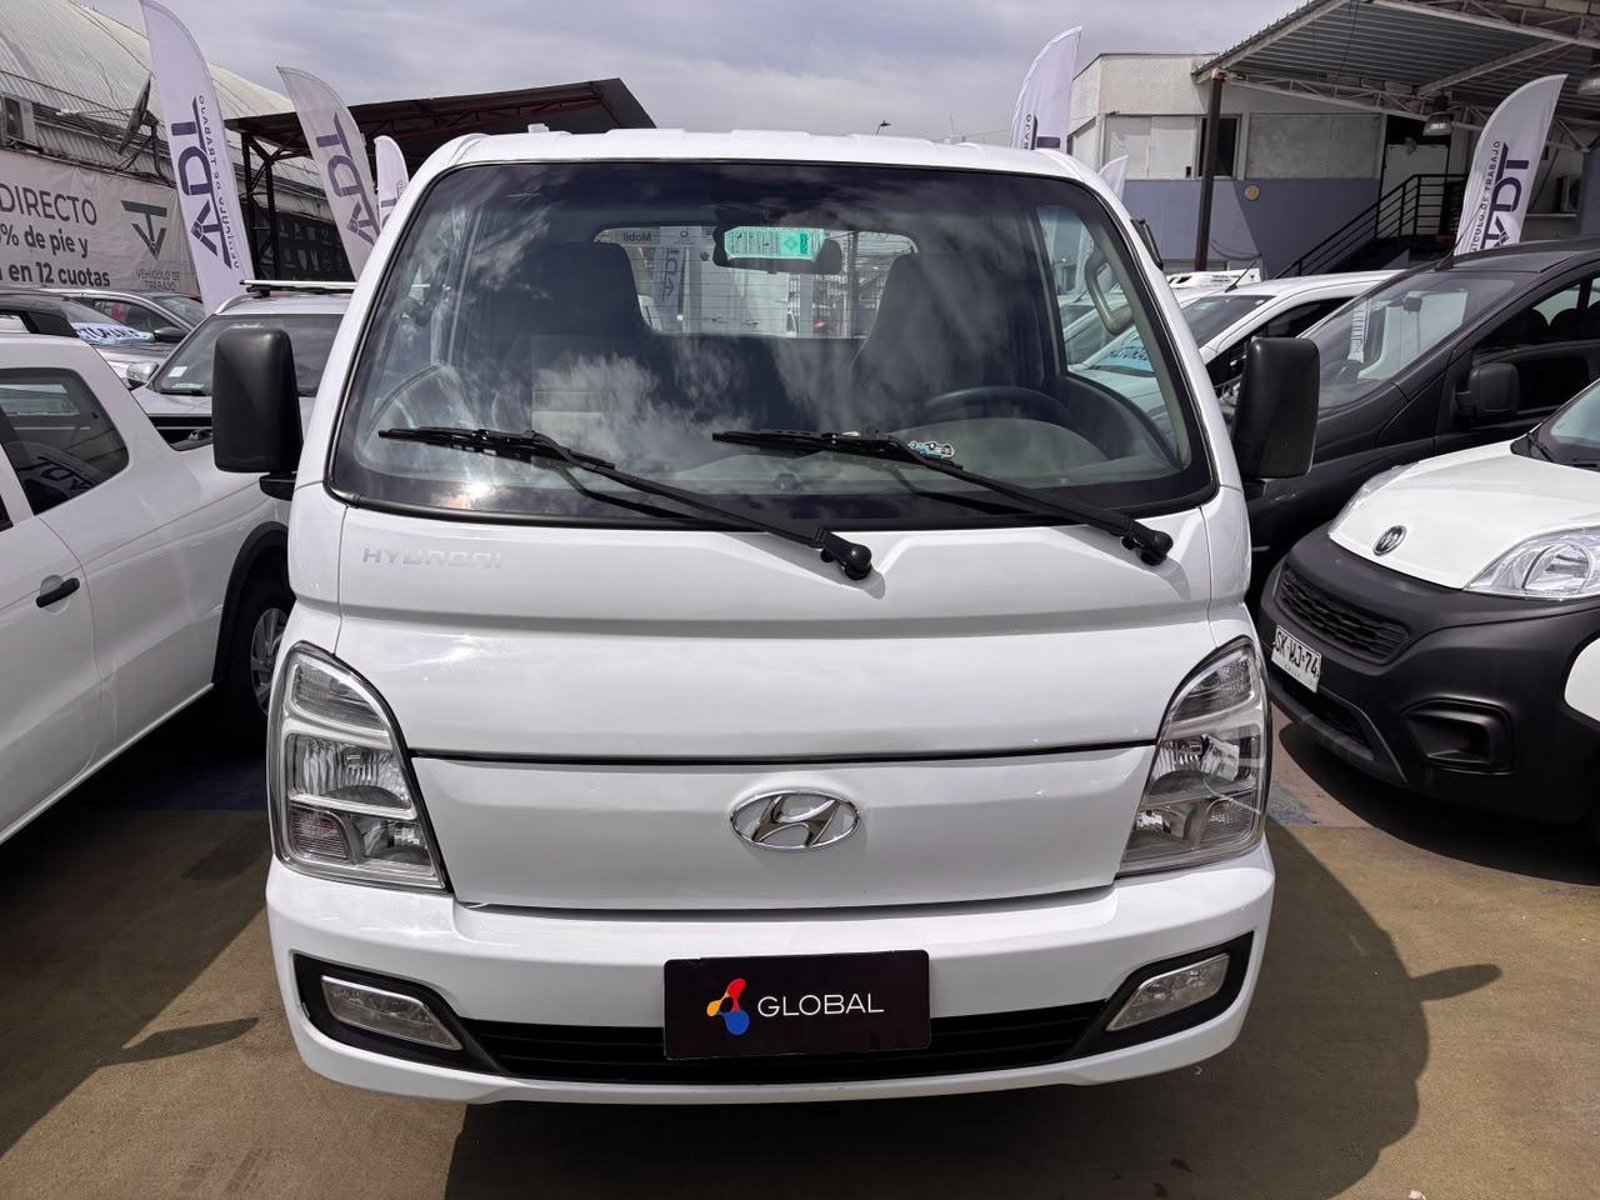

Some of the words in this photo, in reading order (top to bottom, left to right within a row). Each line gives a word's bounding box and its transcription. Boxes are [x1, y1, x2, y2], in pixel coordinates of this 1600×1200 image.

[1484, 141, 1500, 191] TRABAJO
[0, 183, 98, 226] DIRECTO
[24, 224, 46, 249] de
[51, 228, 75, 255] pie
[78, 237, 88, 259] y
[8, 264, 32, 282] en
[36, 262, 54, 284] 12
[57, 268, 111, 287] cuotas
[362, 548, 502, 569] HYUNDAI
[757, 993, 885, 1018] GLOBAL
